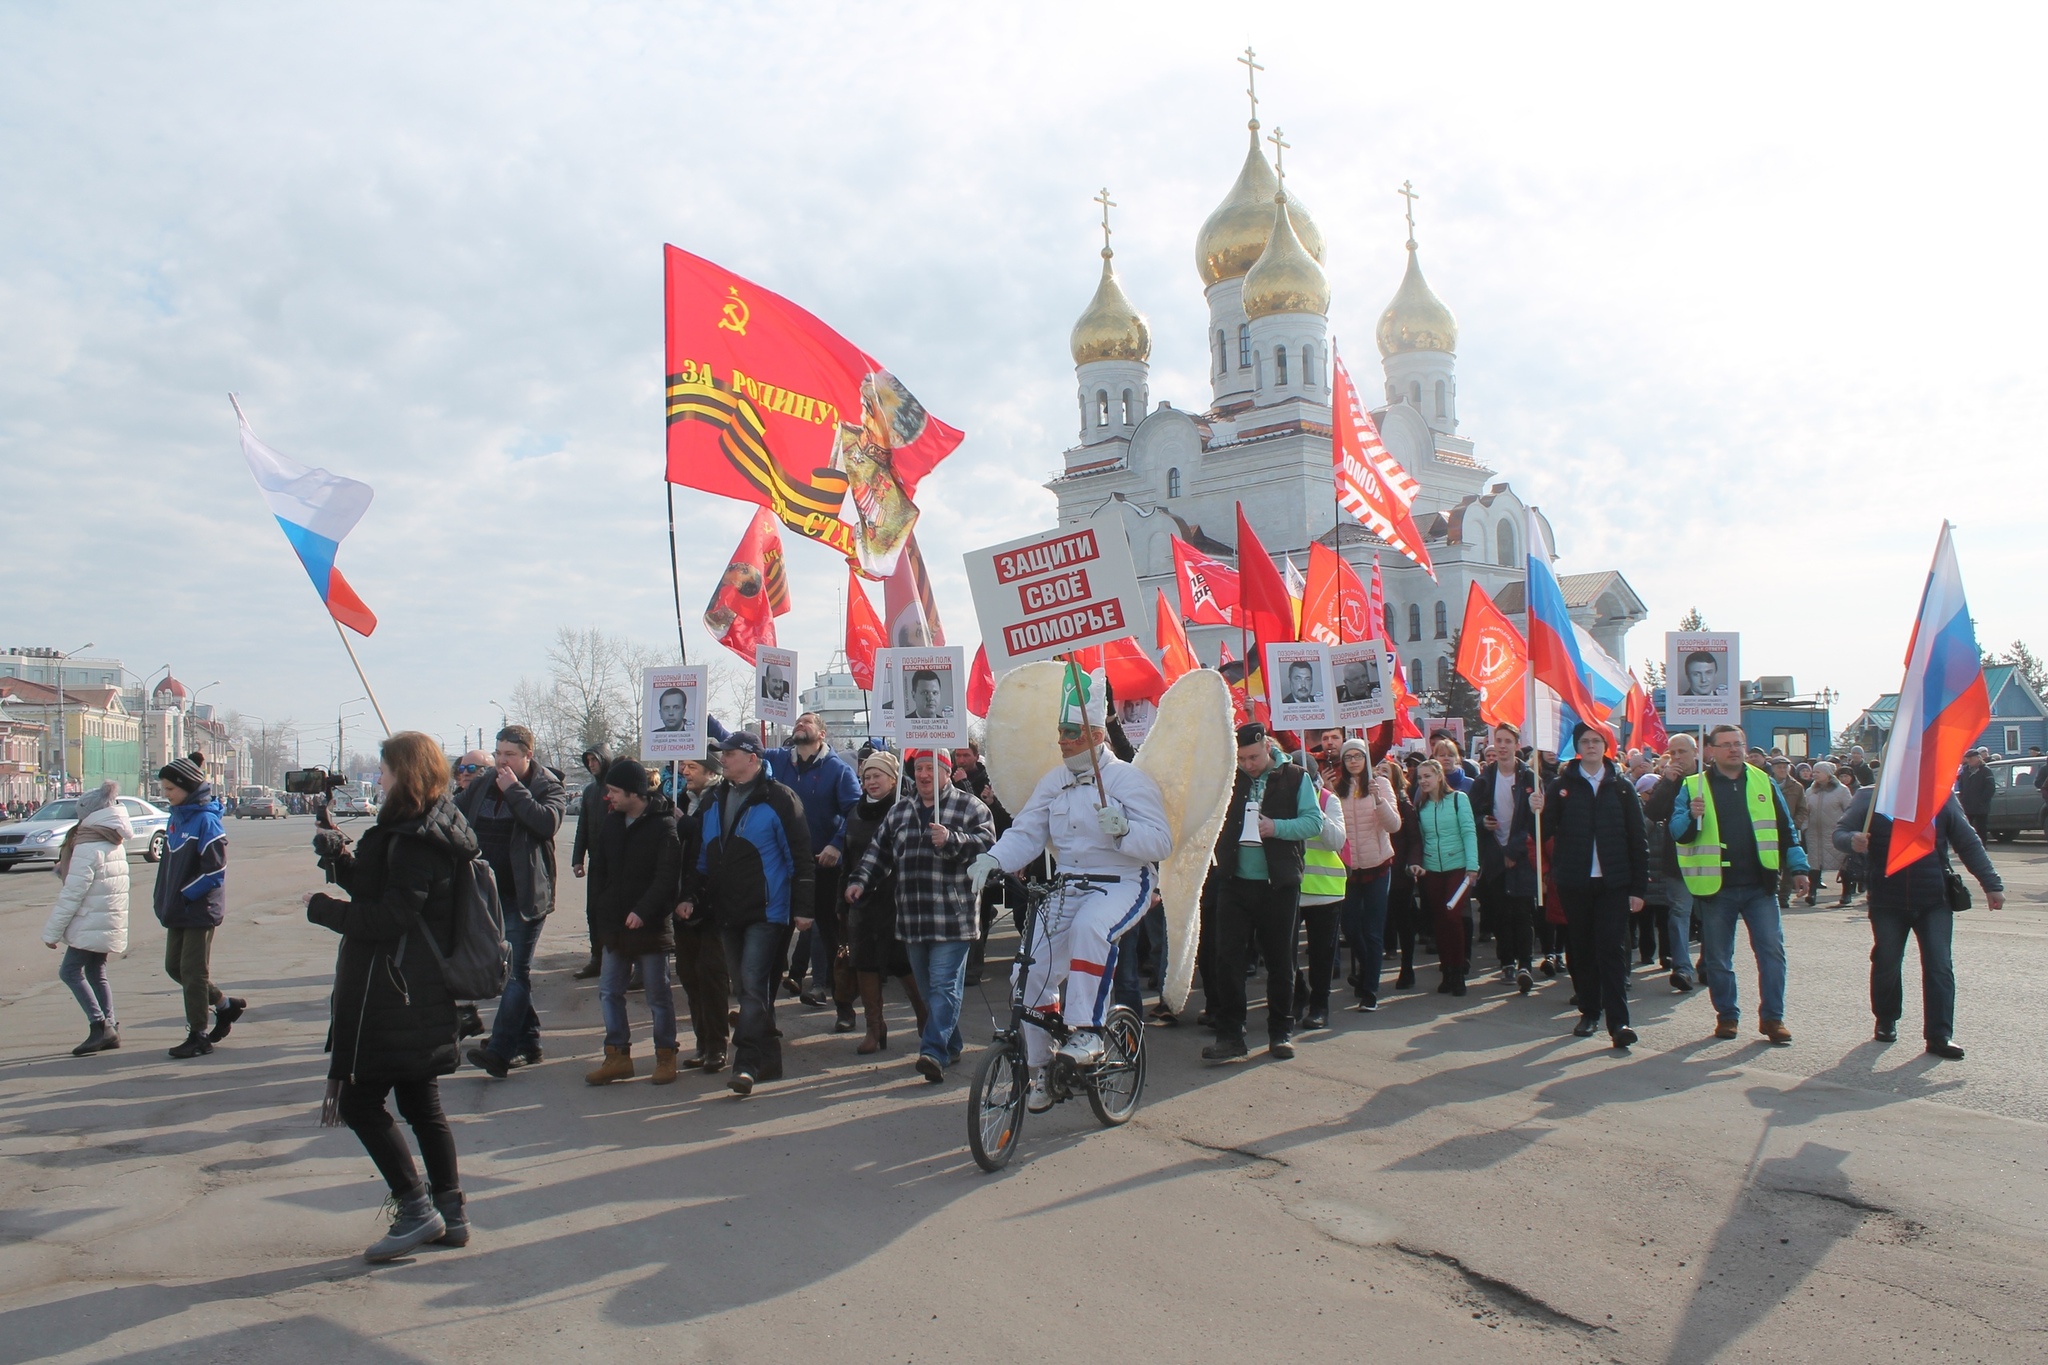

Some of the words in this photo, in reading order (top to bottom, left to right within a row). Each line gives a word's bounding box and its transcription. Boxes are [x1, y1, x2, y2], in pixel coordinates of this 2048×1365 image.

[682, 359, 714, 387] ЗА
[732, 369, 839, 430] РОДИНУ!
[1001, 535, 1093, 579] ЗАЩИТИ
[1026, 570, 1084, 609] СВОЁ
[1010, 604, 1117, 650] ПОМОРЬЕ
[902, 656, 934, 664] ПОЗОРНЫЙ
[936, 655, 952, 663] ПОЛК
[1677, 707, 1699, 716] СЕРГЕЙ
[906, 731, 929, 739] ЕВГЕНИЙ
[930, 731, 956, 739] ФОМЕНКО
[651, 744, 667, 752] СЕРГЕЙ
[1025, 1007, 1045, 1021] STERN
